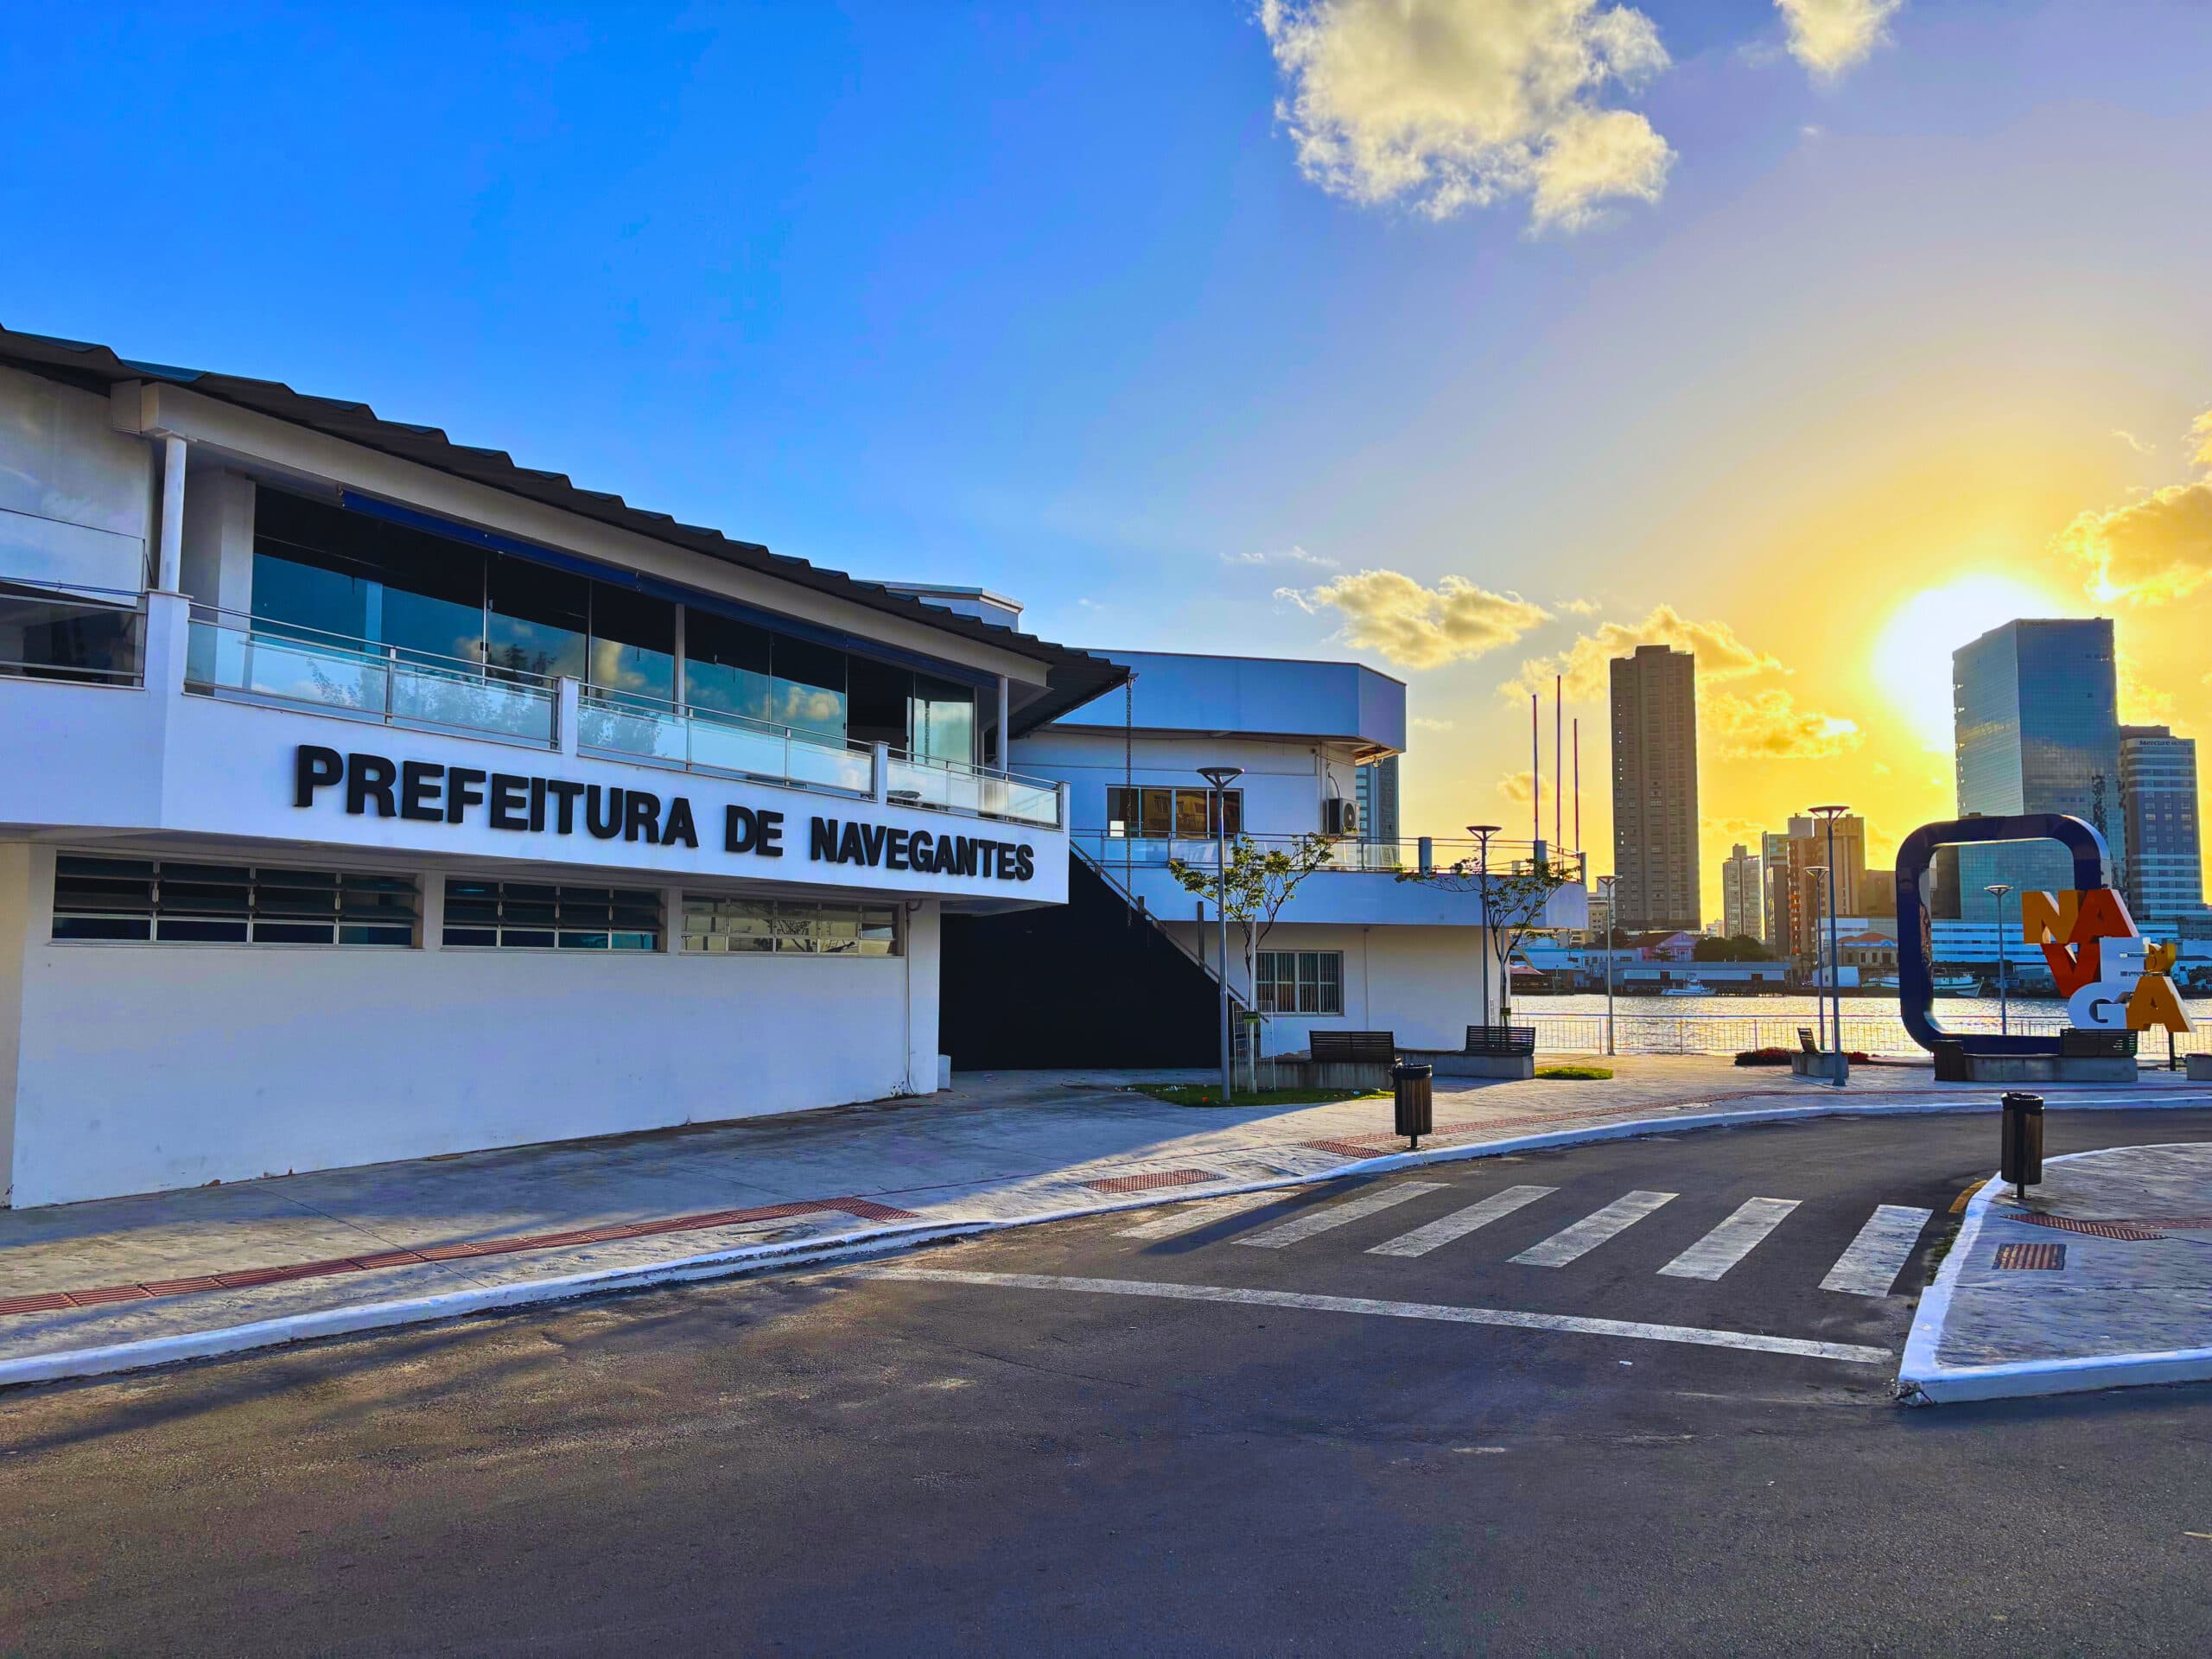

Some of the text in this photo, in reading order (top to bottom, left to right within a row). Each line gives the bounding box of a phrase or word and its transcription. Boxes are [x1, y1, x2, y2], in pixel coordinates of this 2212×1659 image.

[294, 744, 1035, 881] PREFEITURA DE NAVEGANTES
